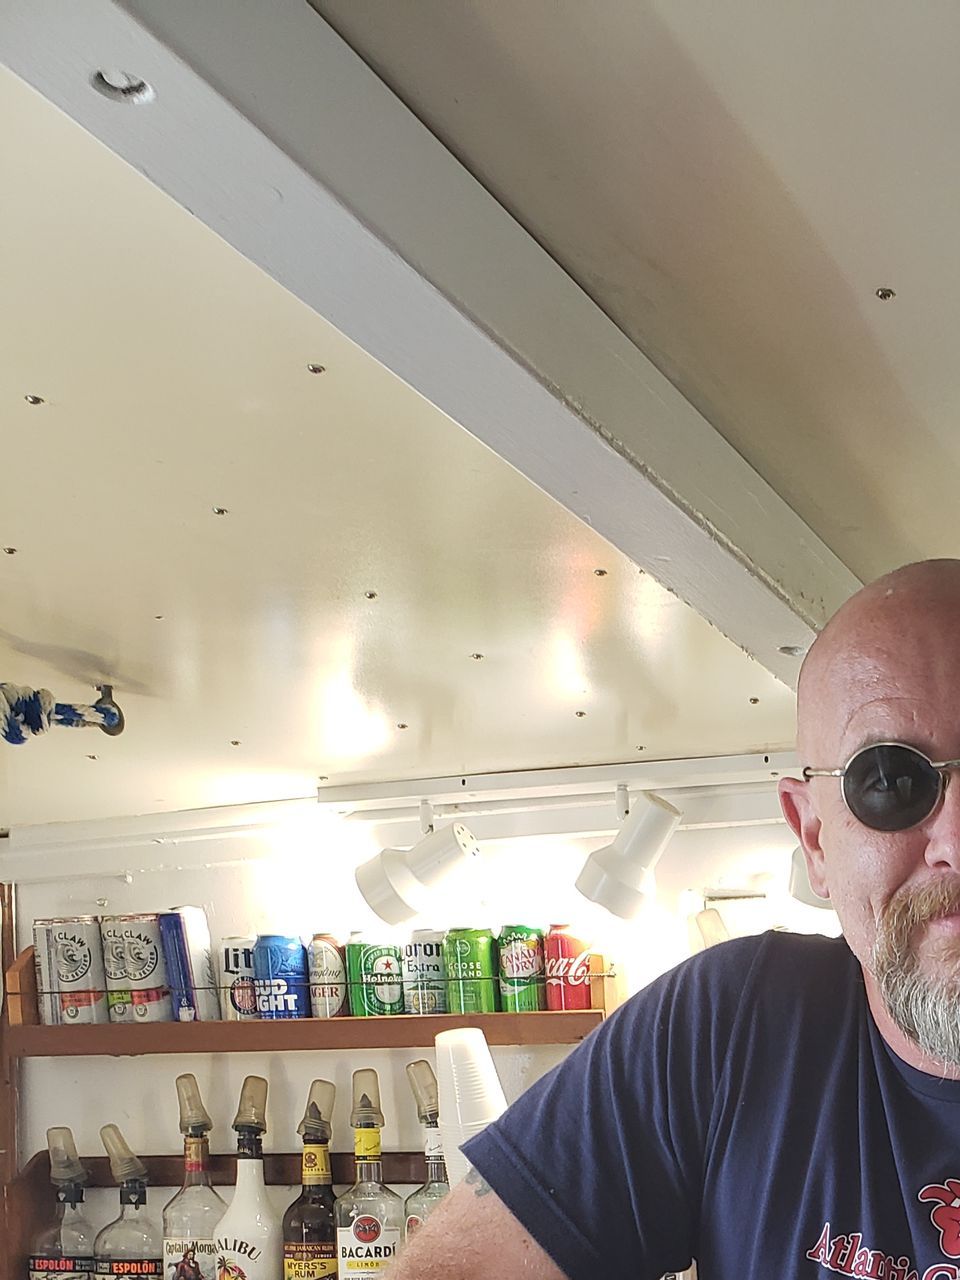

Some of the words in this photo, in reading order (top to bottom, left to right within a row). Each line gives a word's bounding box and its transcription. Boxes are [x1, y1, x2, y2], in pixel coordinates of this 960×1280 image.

[57, 932, 86, 947] CLAW
[124, 930, 152, 945] CLAW
[224, 947, 254, 974] Lit
[407, 959, 440, 972] Extra
[449, 961, 482, 970] GOOSE
[500, 949, 536, 969] CANAD
[511, 958, 535, 973] DRY
[311, 986, 340, 998] AGER
[256, 994, 298, 1011] IGHT
[165, 1242, 189, 1255] Captain
[214, 1237, 262, 1261] ALIBU
[341, 1242, 396, 1259] BACARDÍ
[287, 1261, 327, 1270] MYERS'S
[294, 1270, 316, 1279] RUM
